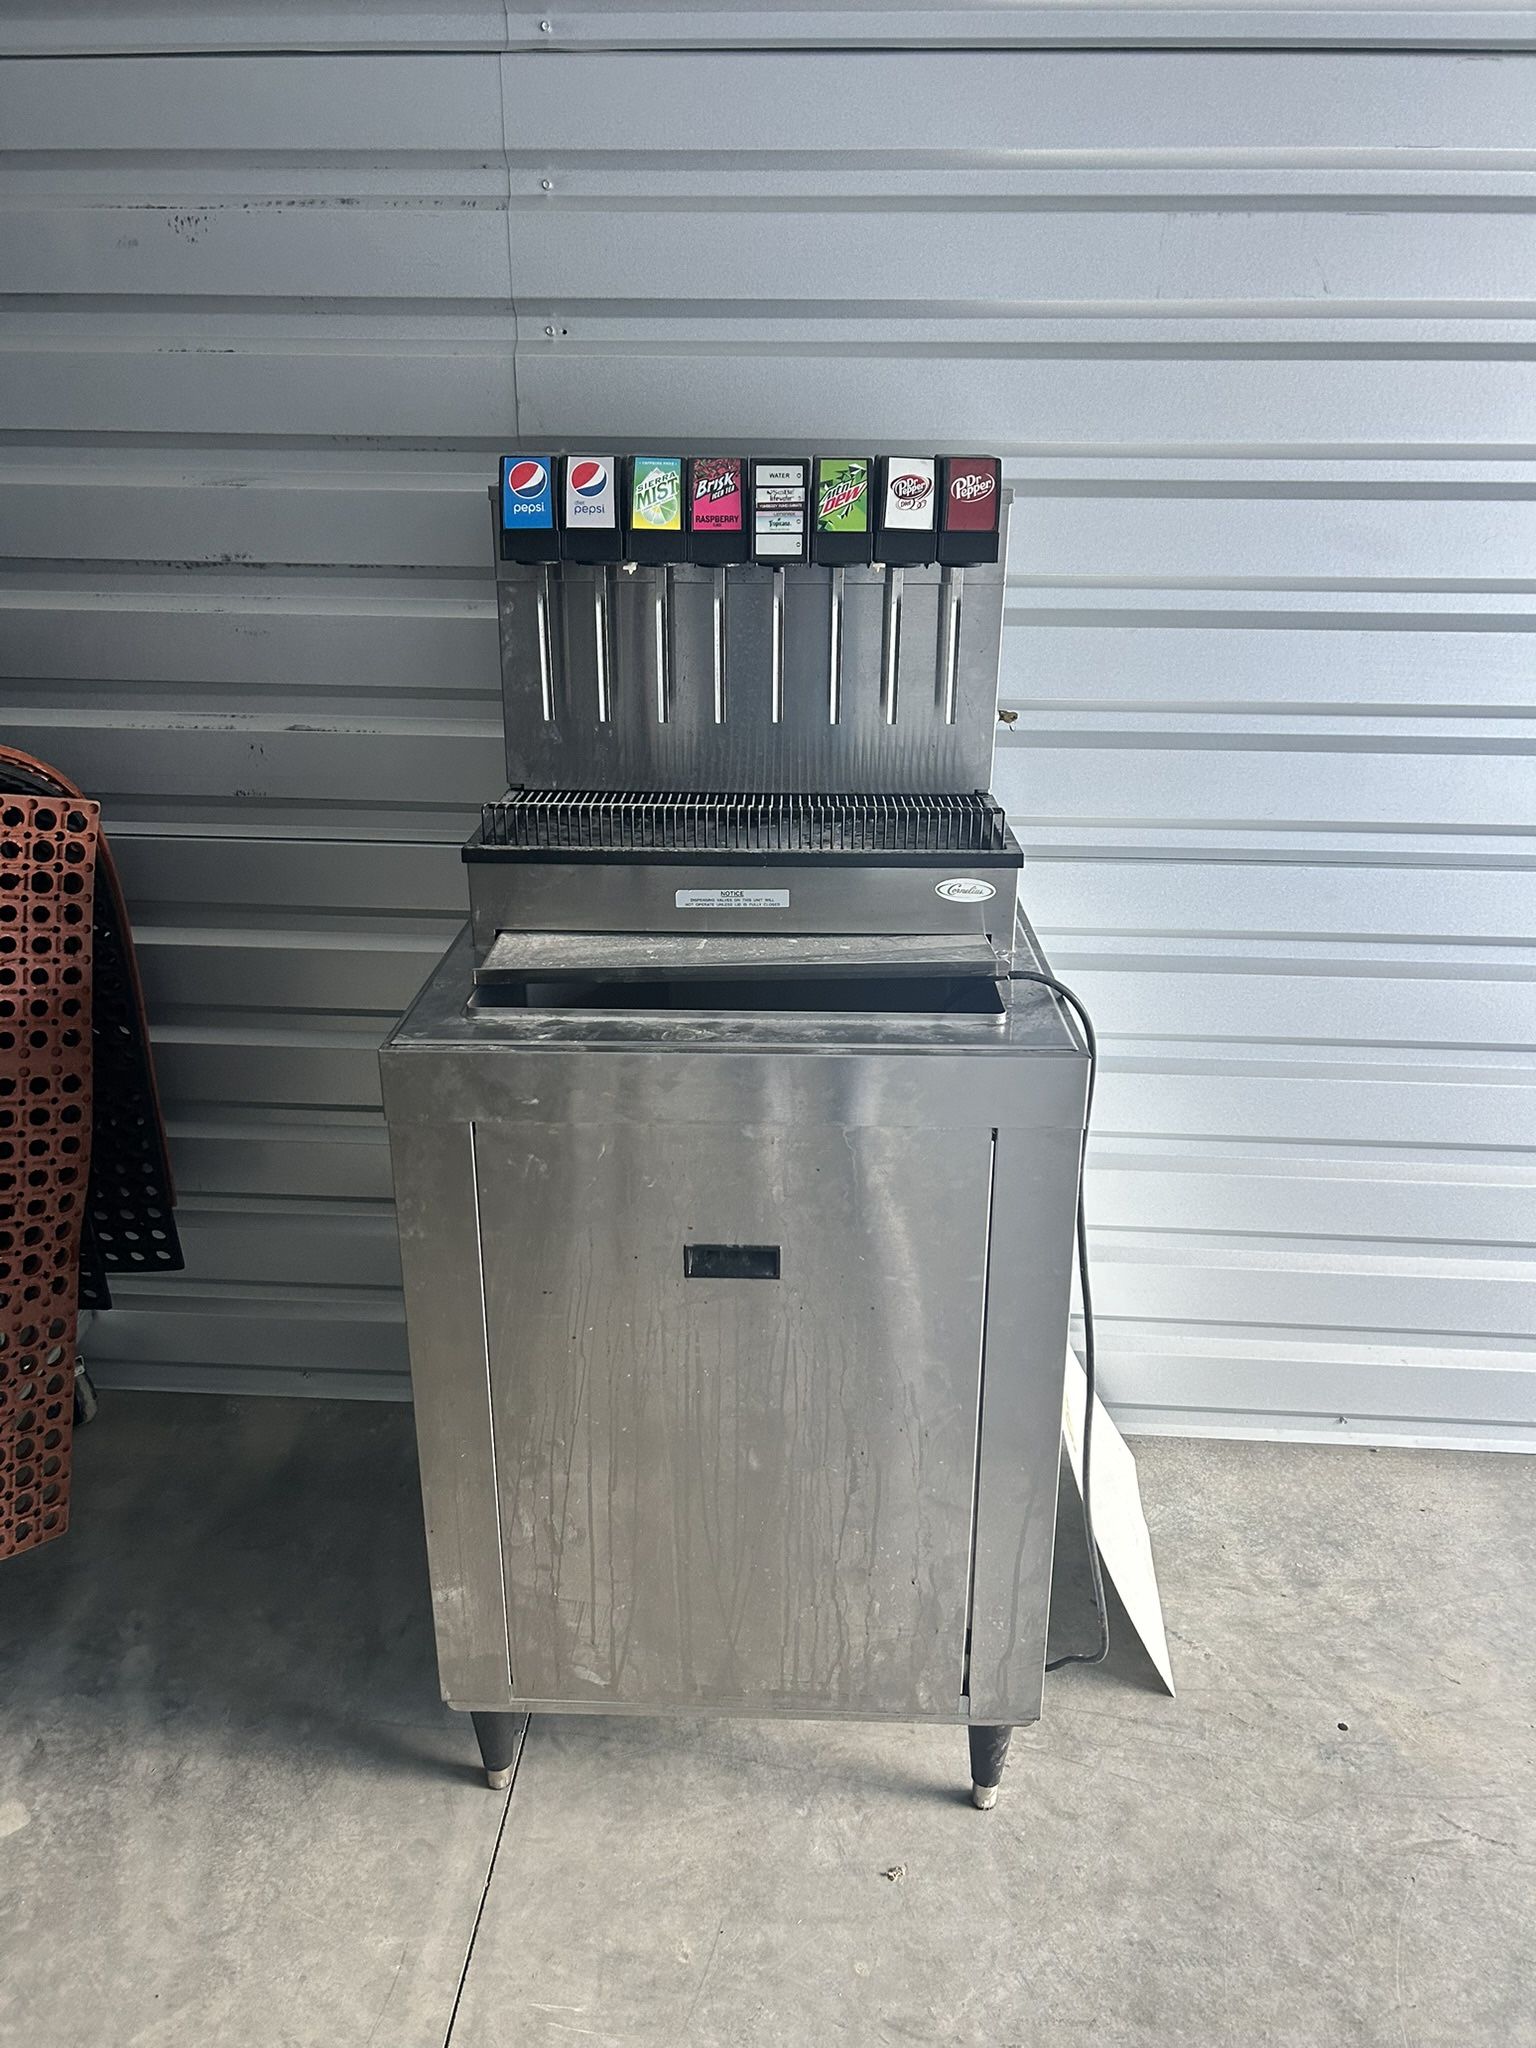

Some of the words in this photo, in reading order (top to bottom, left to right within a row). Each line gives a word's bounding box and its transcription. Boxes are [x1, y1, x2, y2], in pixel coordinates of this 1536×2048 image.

[637, 471, 676, 492] SIERRA
[898, 480, 926, 496] Pepper
[906, 478, 918, 488] Dr
[966, 474, 982, 488] Dr
[637, 477, 678, 510] MIST
[956, 478, 992, 500] Pepper
[513, 502, 545, 515] pepsi
[574, 504, 605, 515] pepsi
[695, 515, 739, 523] RASPBERRY
